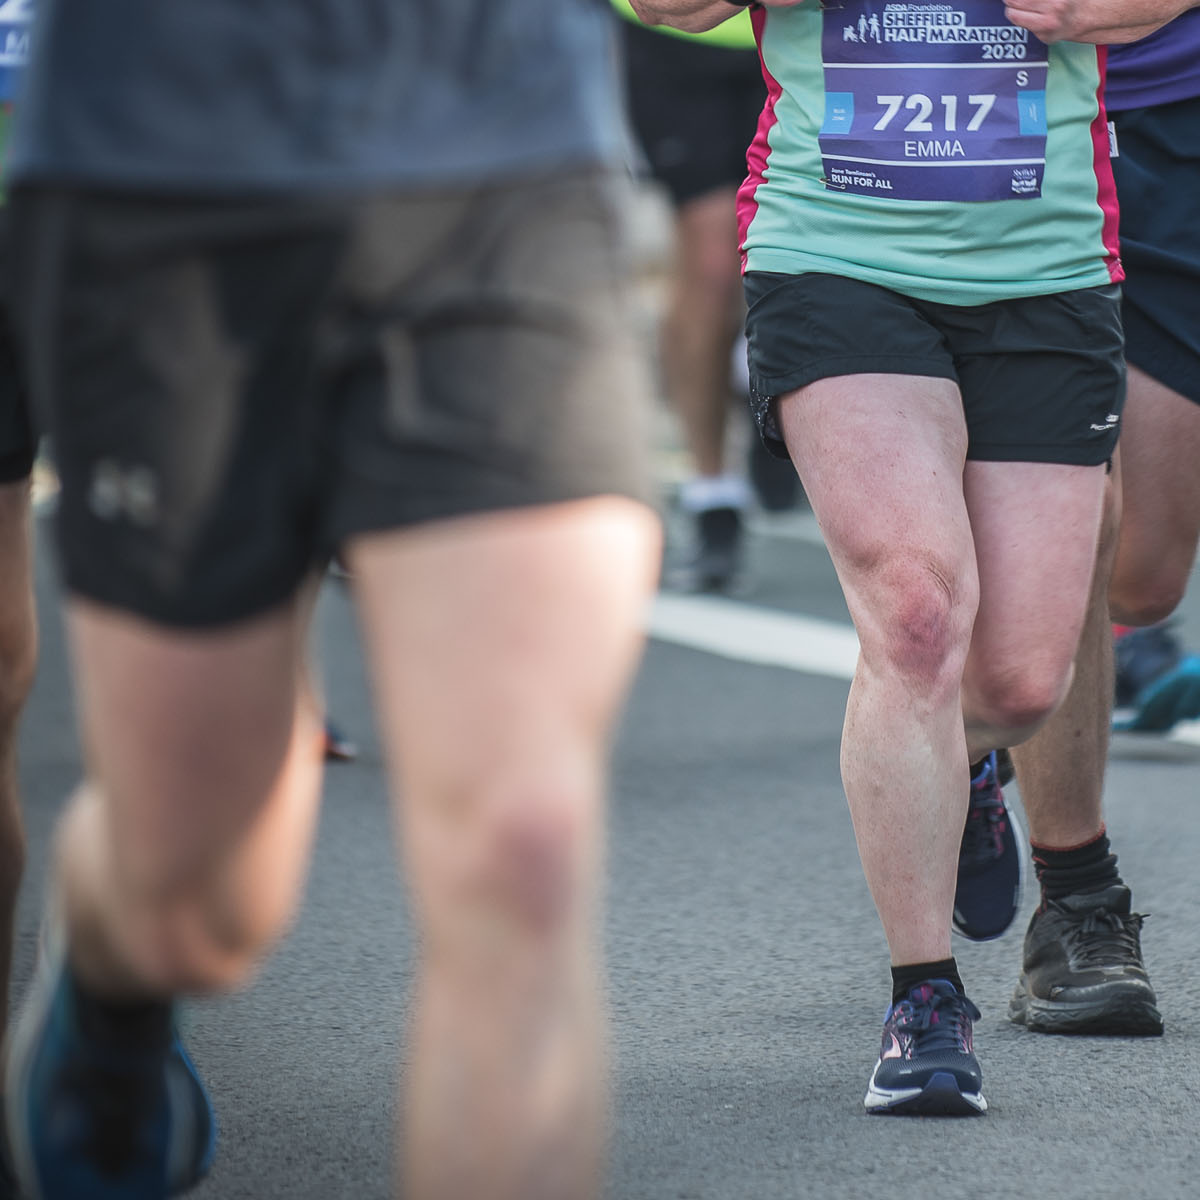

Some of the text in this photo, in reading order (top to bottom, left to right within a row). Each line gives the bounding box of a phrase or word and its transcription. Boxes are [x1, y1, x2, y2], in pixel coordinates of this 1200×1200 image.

[884, 13, 963, 26] SHEFFIELD
[884, 27, 1027, 42] HALF MARATHON
[981, 45, 1027, 59] 2020
[1016, 71, 1029, 87] S
[873, 94, 997, 132] 7217
[904, 140, 965, 157] EMMA
[832, 174, 893, 189] RUN FOR ALL
